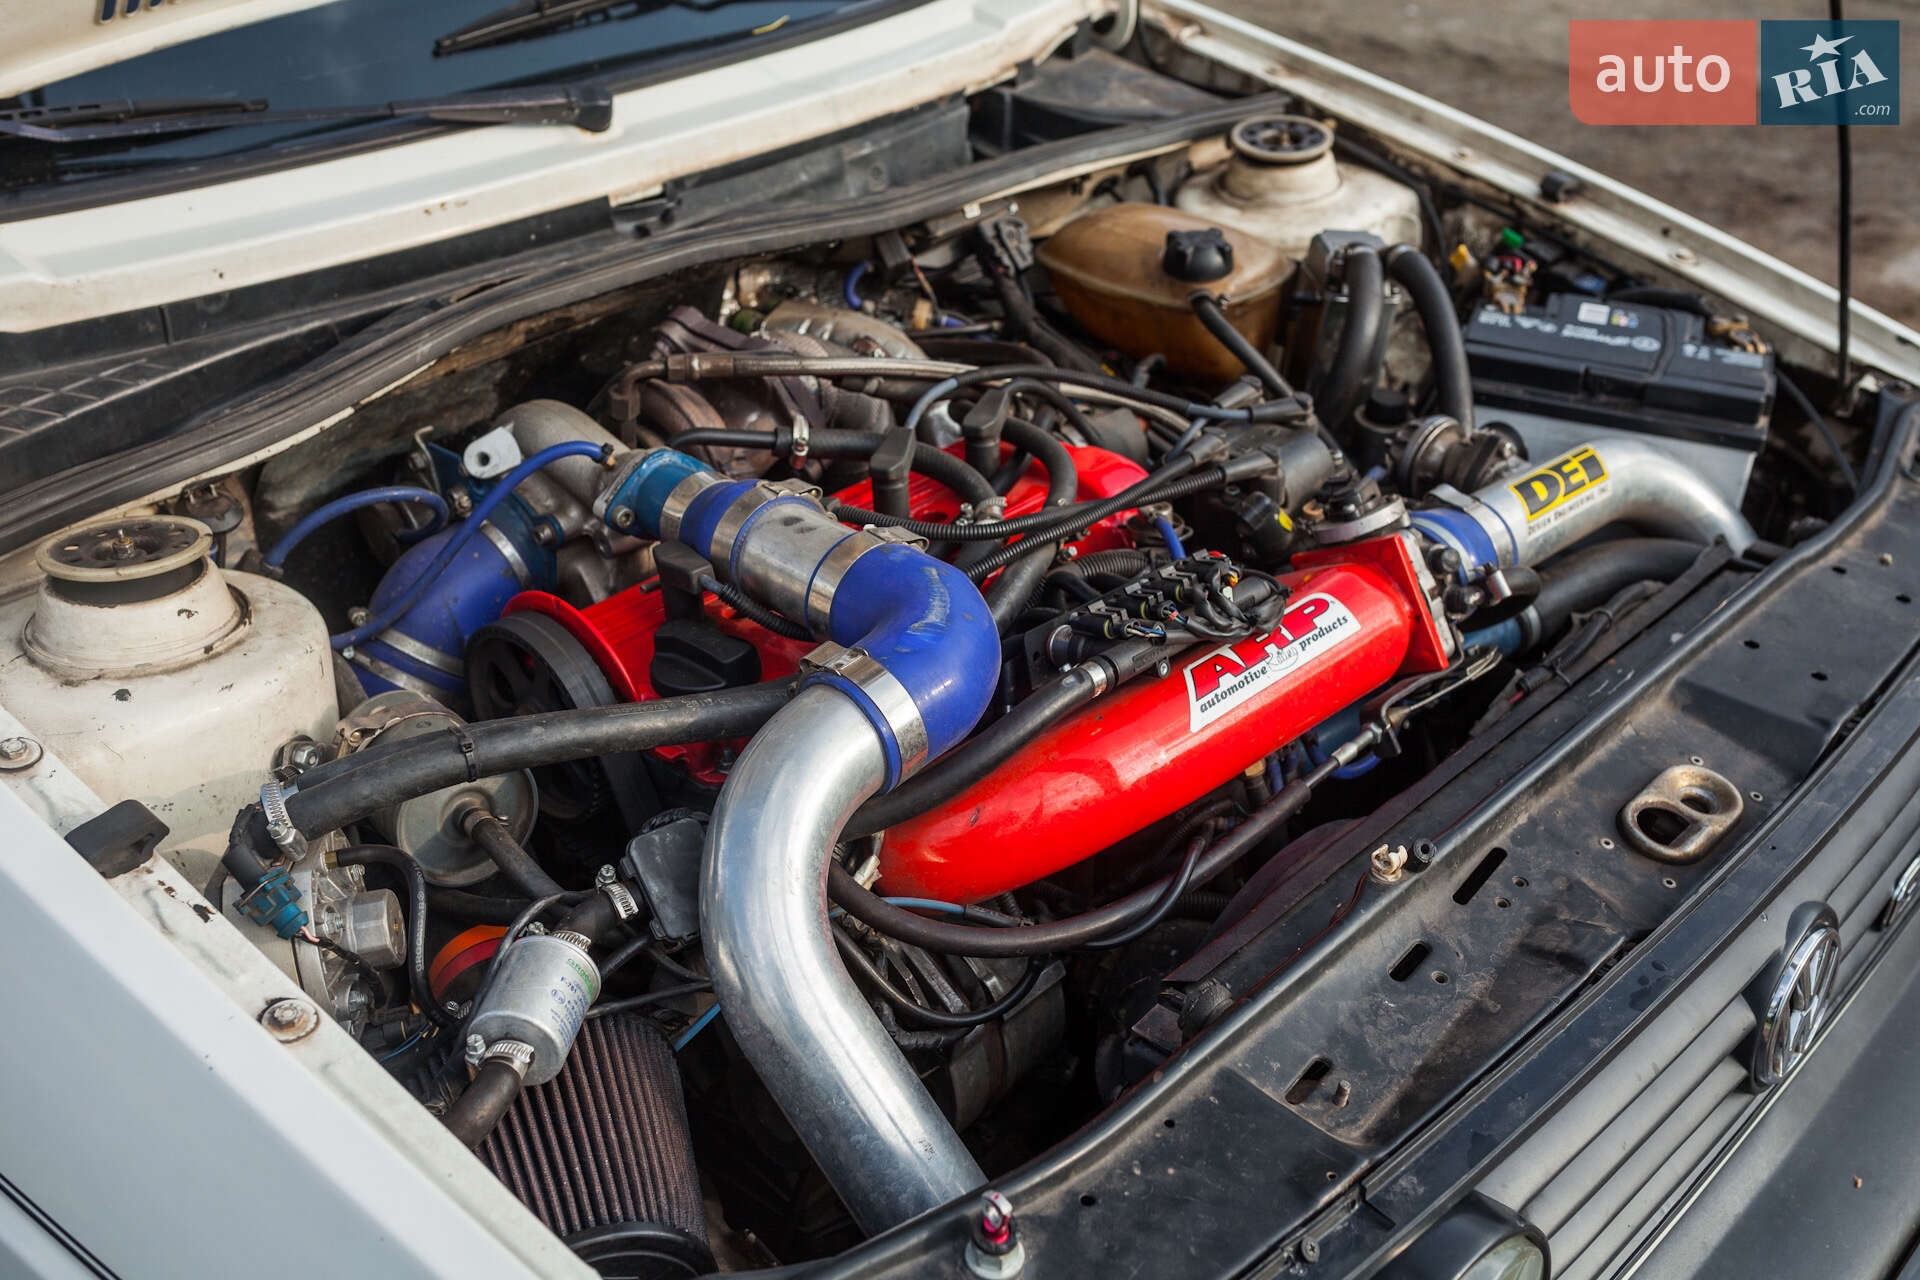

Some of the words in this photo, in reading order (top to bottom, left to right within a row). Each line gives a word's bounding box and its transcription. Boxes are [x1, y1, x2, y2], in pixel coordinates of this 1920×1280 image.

[1191, 597, 1331, 702] ARP
[1200, 663, 1268, 713] automotive
[1299, 615, 1349, 652] products
